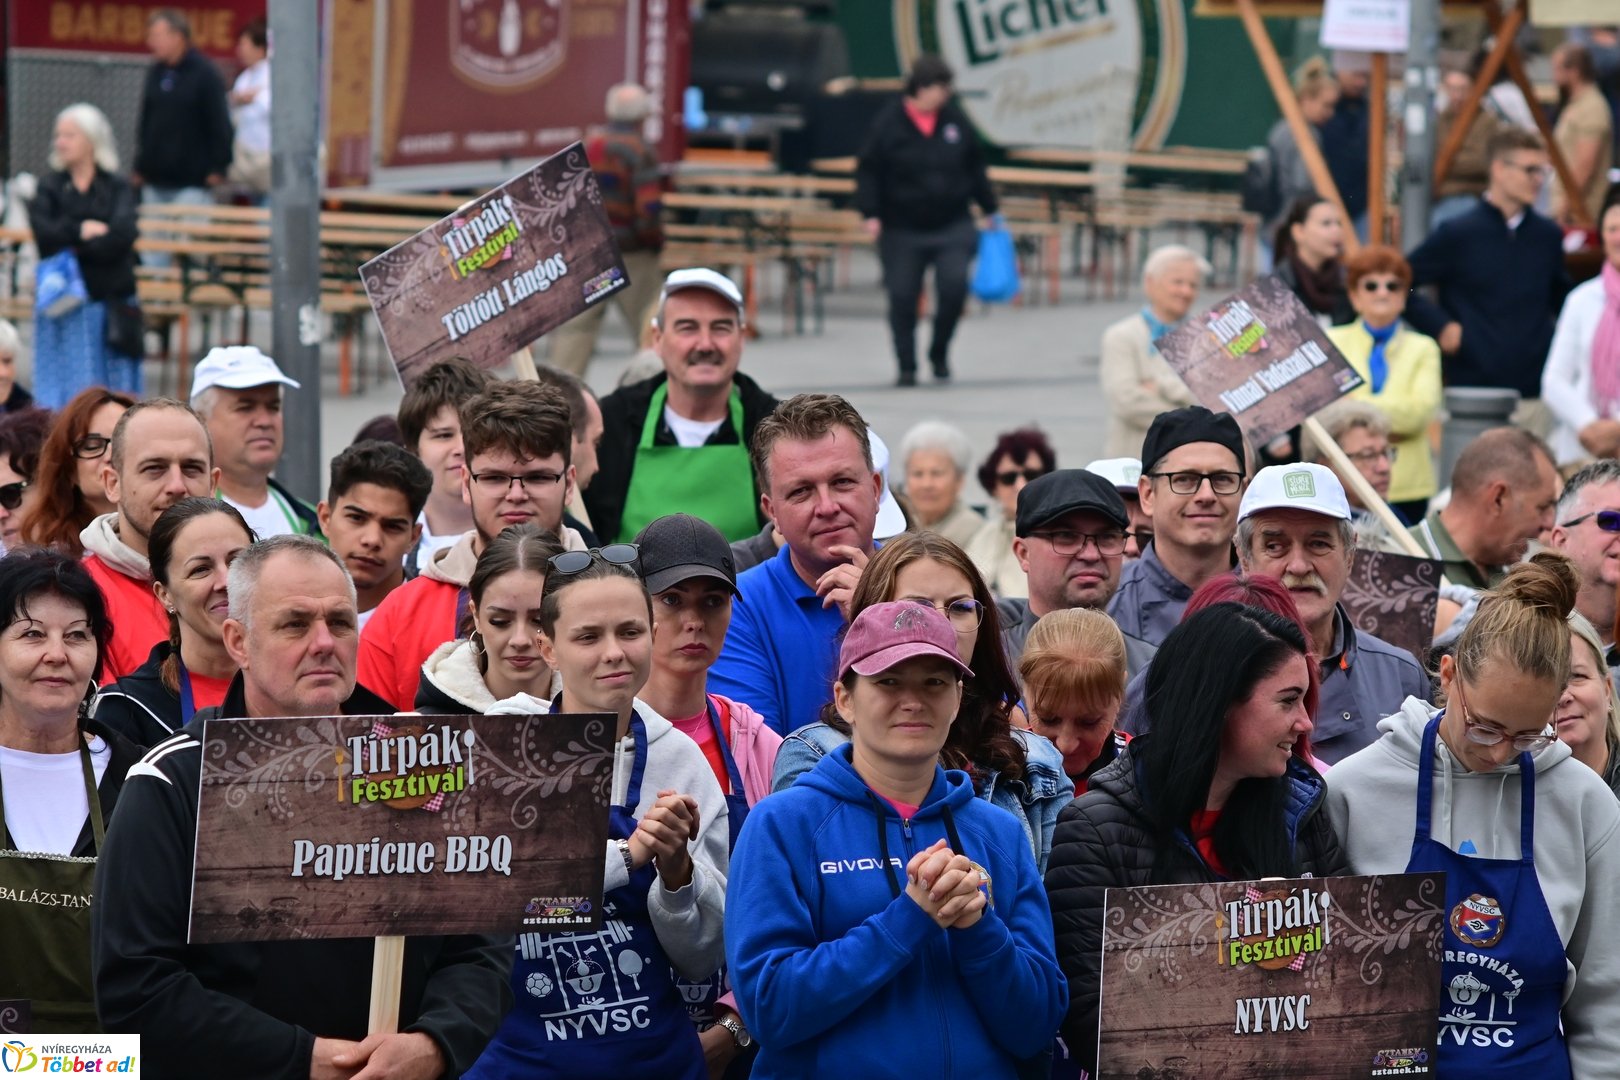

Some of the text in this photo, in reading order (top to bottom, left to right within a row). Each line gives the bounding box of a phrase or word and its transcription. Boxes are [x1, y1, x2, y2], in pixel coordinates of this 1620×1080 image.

[51, 2, 235, 49] BARBUE
[442, 198, 512, 260] Tirpák
[457, 221, 519, 278] Fesztivál
[441, 286, 505, 341] Töltött
[501, 252, 568, 307] Lángos
[347, 724, 464, 776] Tirpák
[352, 766, 465, 804] Fesztivál
[291, 834, 513, 881] Papricue BBQ
[523, 915, 592, 925] sztanek.hu
[1226, 888, 1321, 939] Tirpák
[1469, 901, 1496, 915] NYVSC
[1230, 926, 1322, 966] Fesztivál
[545, 1004, 651, 1041] NYVSC
[1234, 994, 1311, 1035] NYVSC
[1371, 1065, 1429, 1076] sztanek.hu
